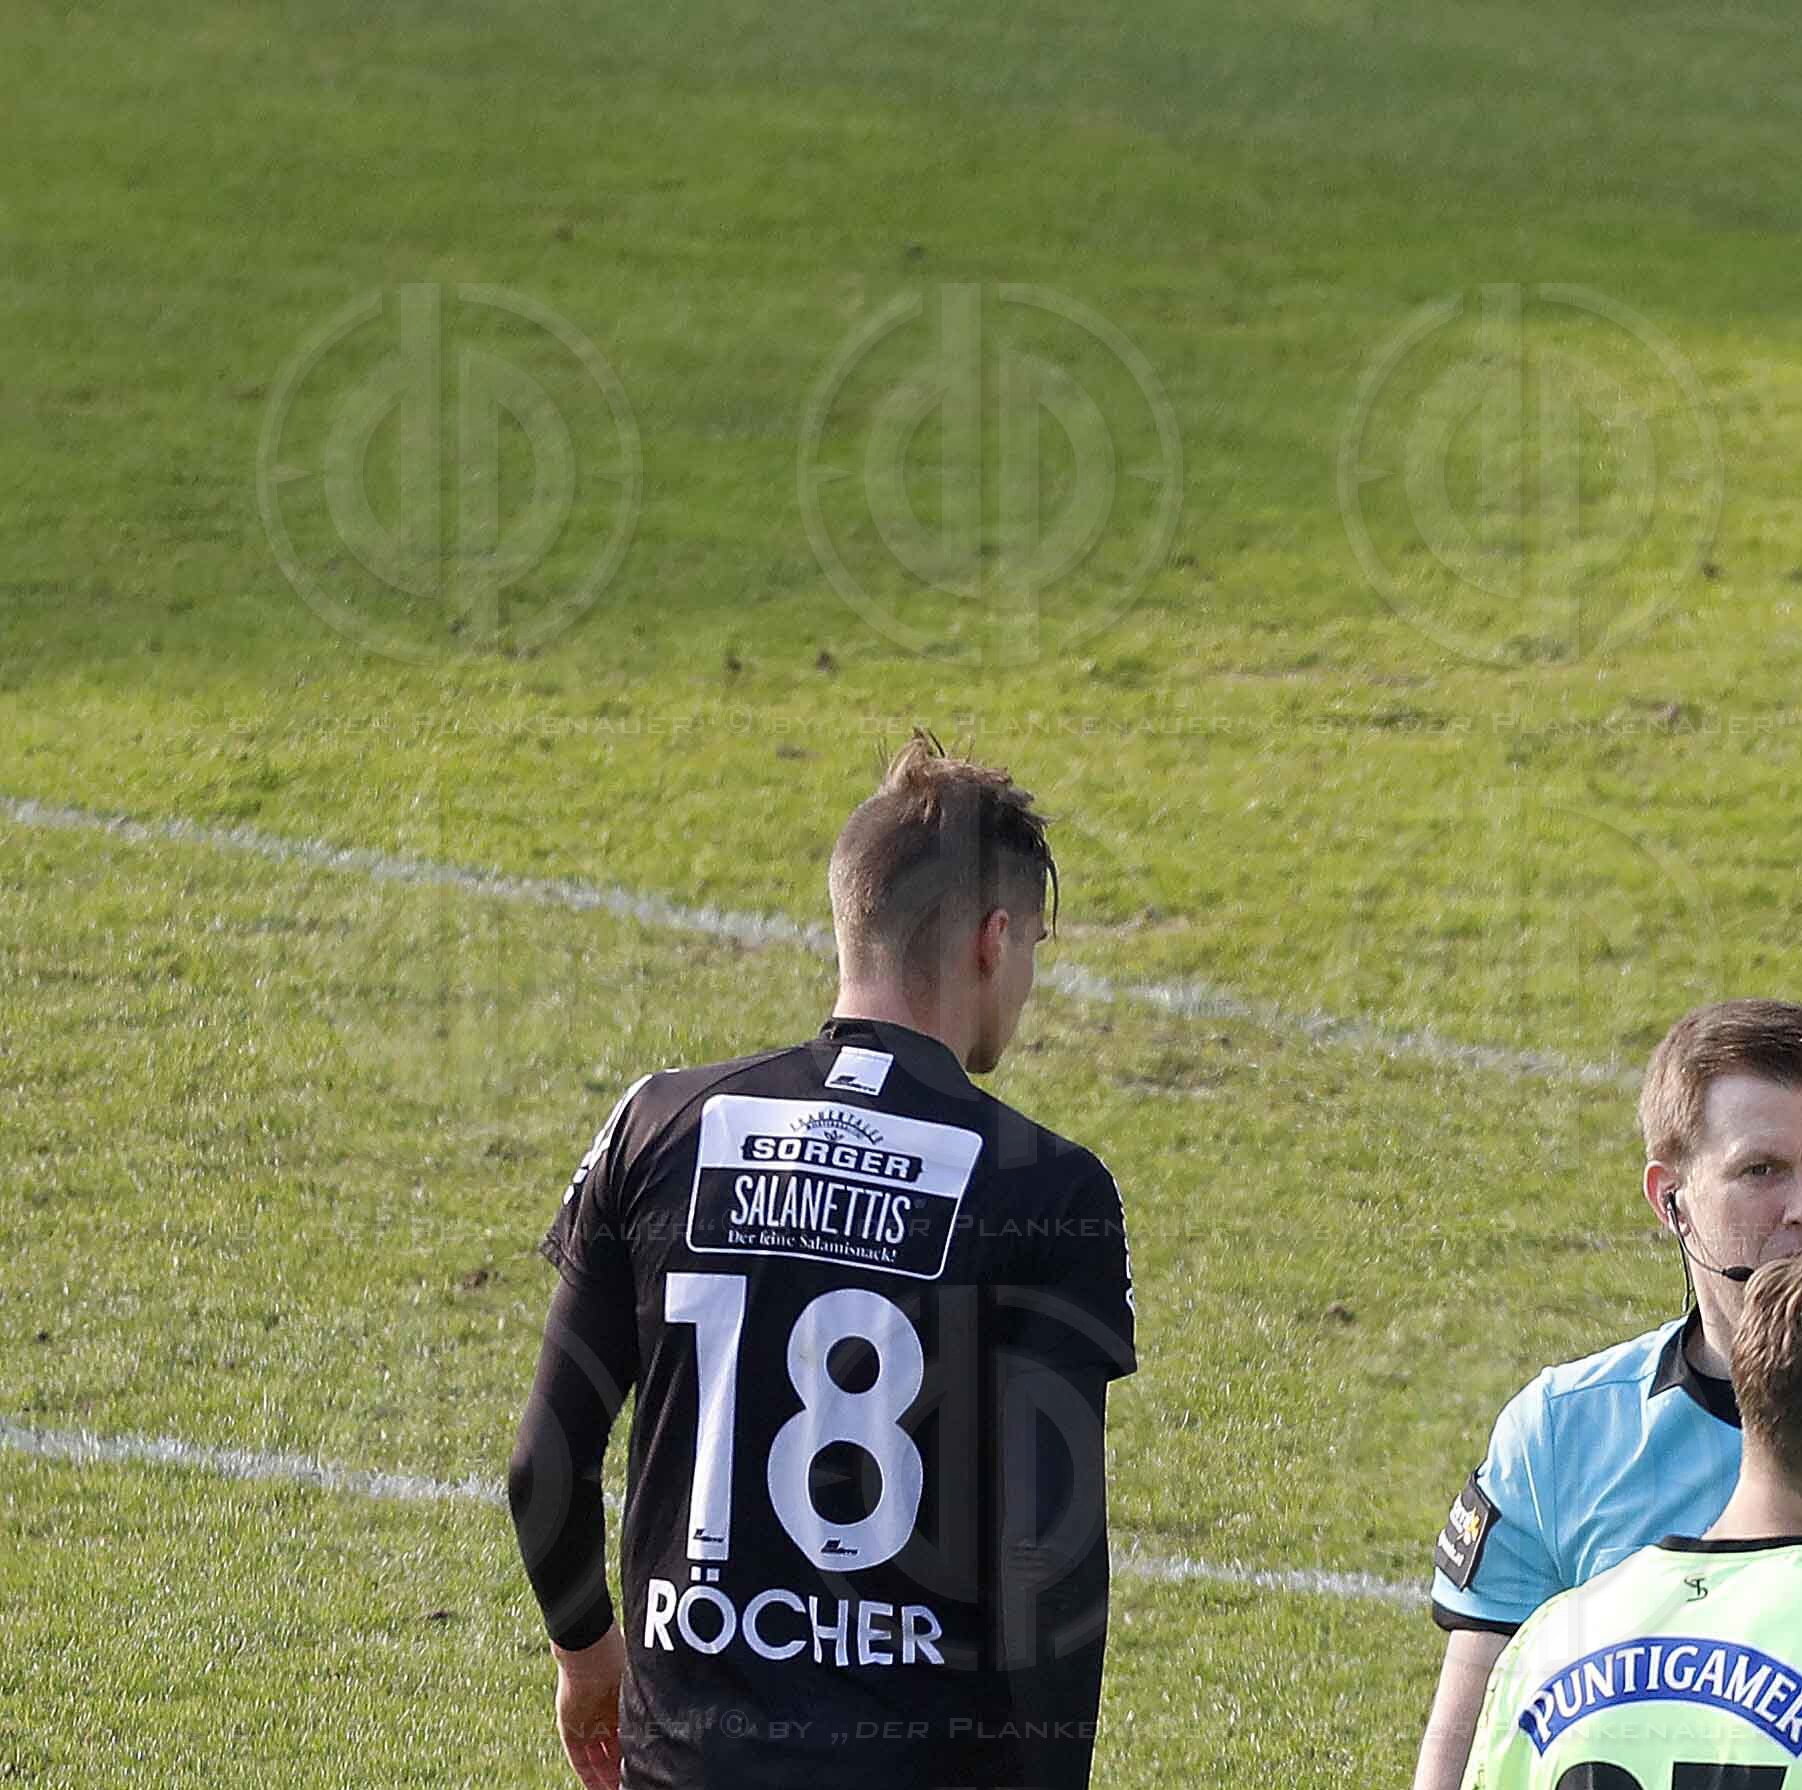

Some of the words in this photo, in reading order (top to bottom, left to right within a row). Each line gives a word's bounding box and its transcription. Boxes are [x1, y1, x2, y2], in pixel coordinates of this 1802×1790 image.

[751, 1137, 911, 1179] SORGER
[728, 1229, 756, 1244] Der
[730, 1175, 911, 1244] SALANETTIS
[664, 1271, 924, 1572] 18
[643, 1565, 945, 1667] RÖCHER
